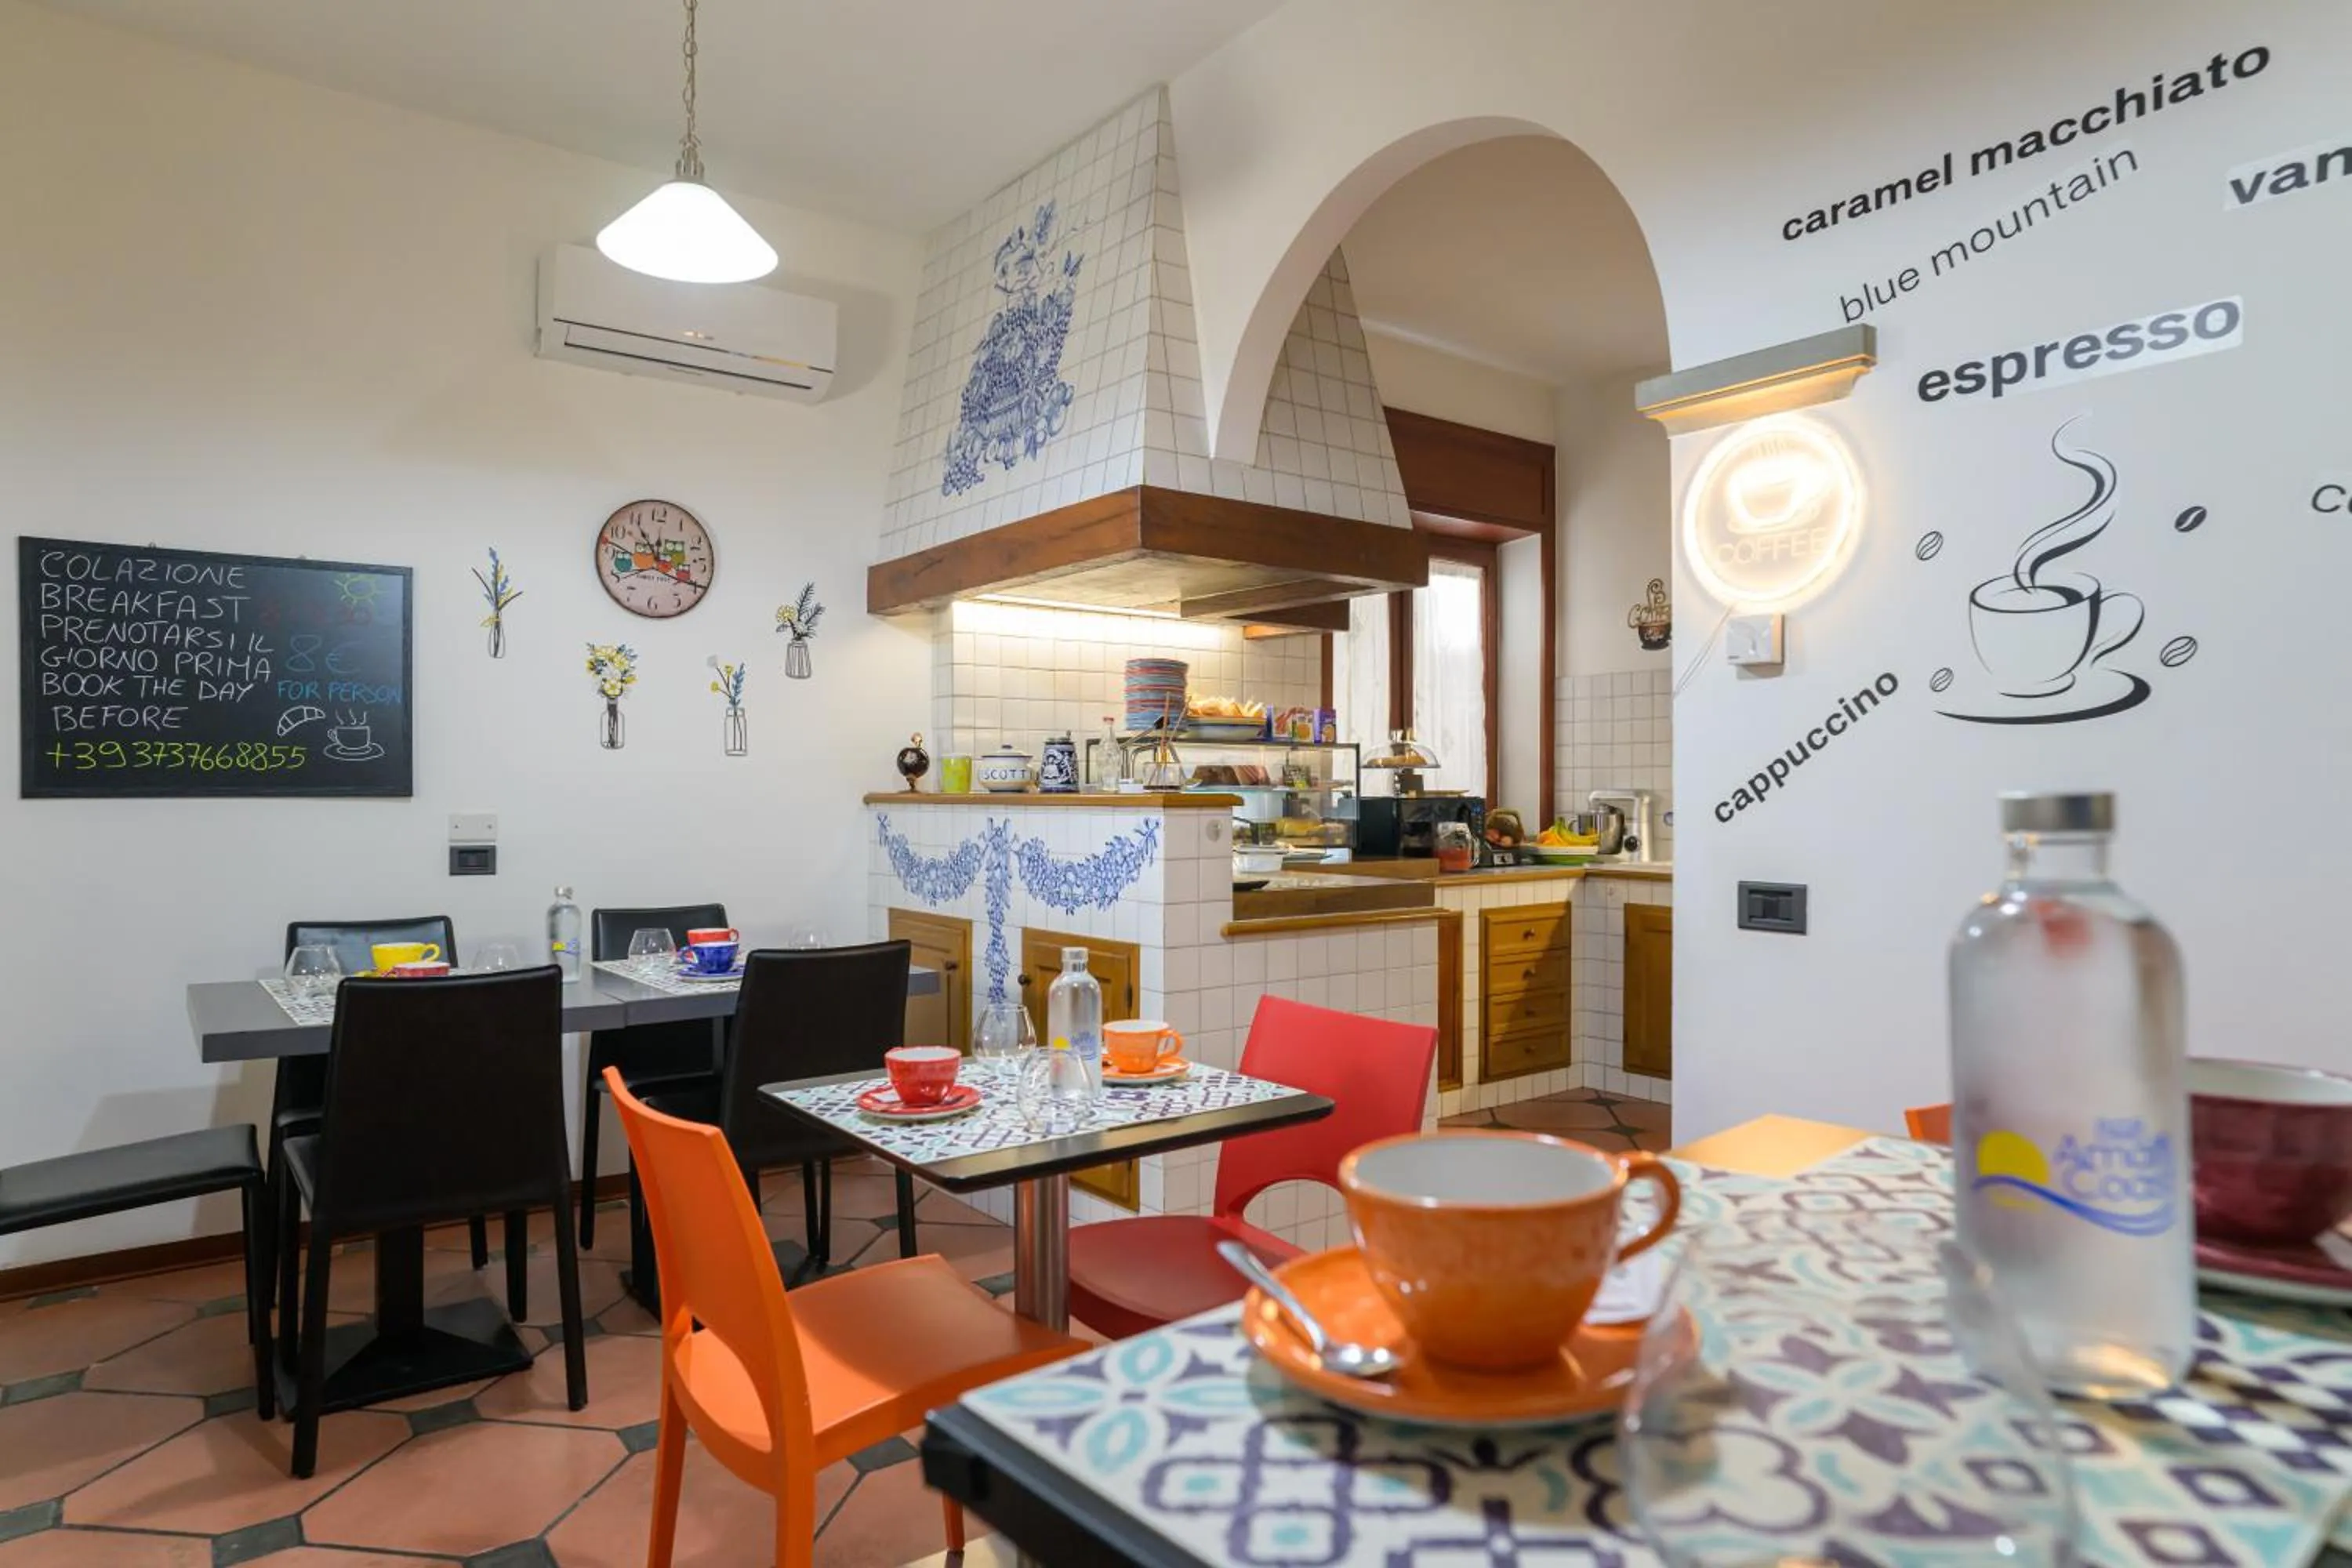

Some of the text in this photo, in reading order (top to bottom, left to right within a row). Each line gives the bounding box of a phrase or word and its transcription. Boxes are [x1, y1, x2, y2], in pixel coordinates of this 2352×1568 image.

[1782, 46, 2270, 241] caramel macchiato
[1839, 148, 2139, 323] blue mountain
[1917, 301, 2241, 402] espresso
[1718, 527, 1828, 564] COFFEE
[40, 550, 246, 589] COLAZIONE
[40, 583, 251, 623] BREAKFAST
[41, 614, 274, 652] PRENOTARSI IL
[41, 645, 271, 683] GIORNO PRIMA
[42, 672, 255, 702] BOOK THE DAY
[278, 680, 402, 704] FOR PERSON
[52, 706, 189, 731] BEFORE
[1714, 672, 1899, 823] cappuccino
